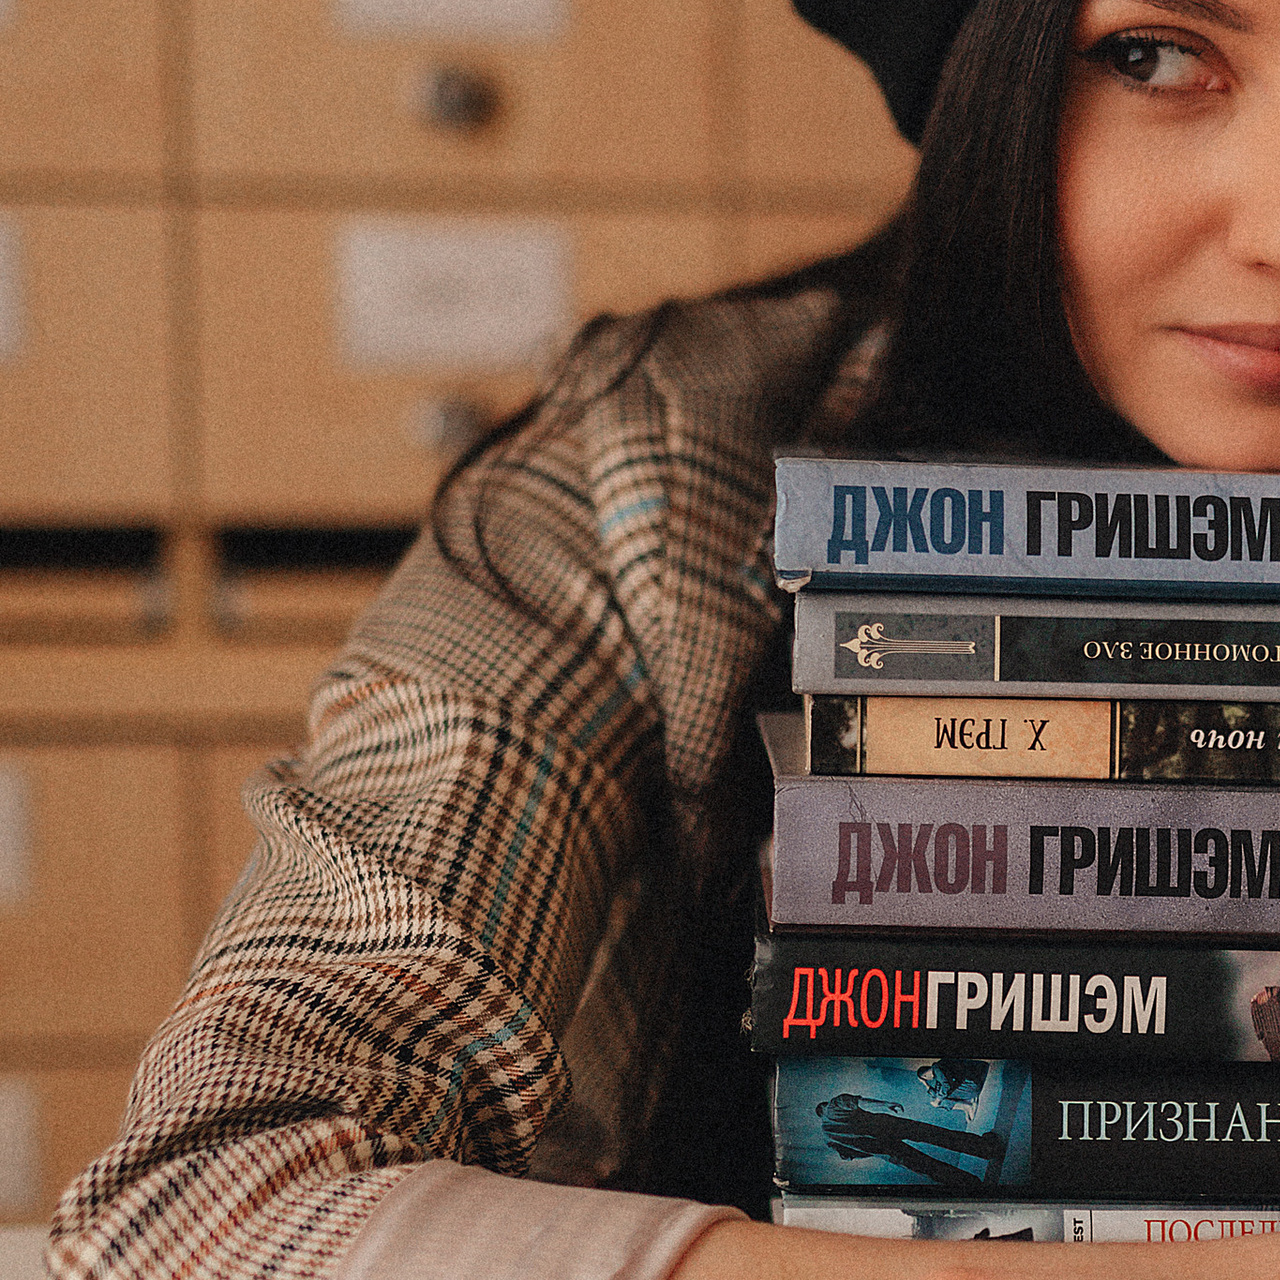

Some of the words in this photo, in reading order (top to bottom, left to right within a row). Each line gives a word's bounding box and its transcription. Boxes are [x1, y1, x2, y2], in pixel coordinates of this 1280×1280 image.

[826, 484, 1004, 565] ДЖОН
[1083, 640, 1134, 660] ЗЛО
[933, 717, 1009, 750] ГРЭМ
[1023, 719, 1051, 751] Х.
[1189, 728, 1267, 751] ночь
[831, 821, 1008, 905] ДЖОН
